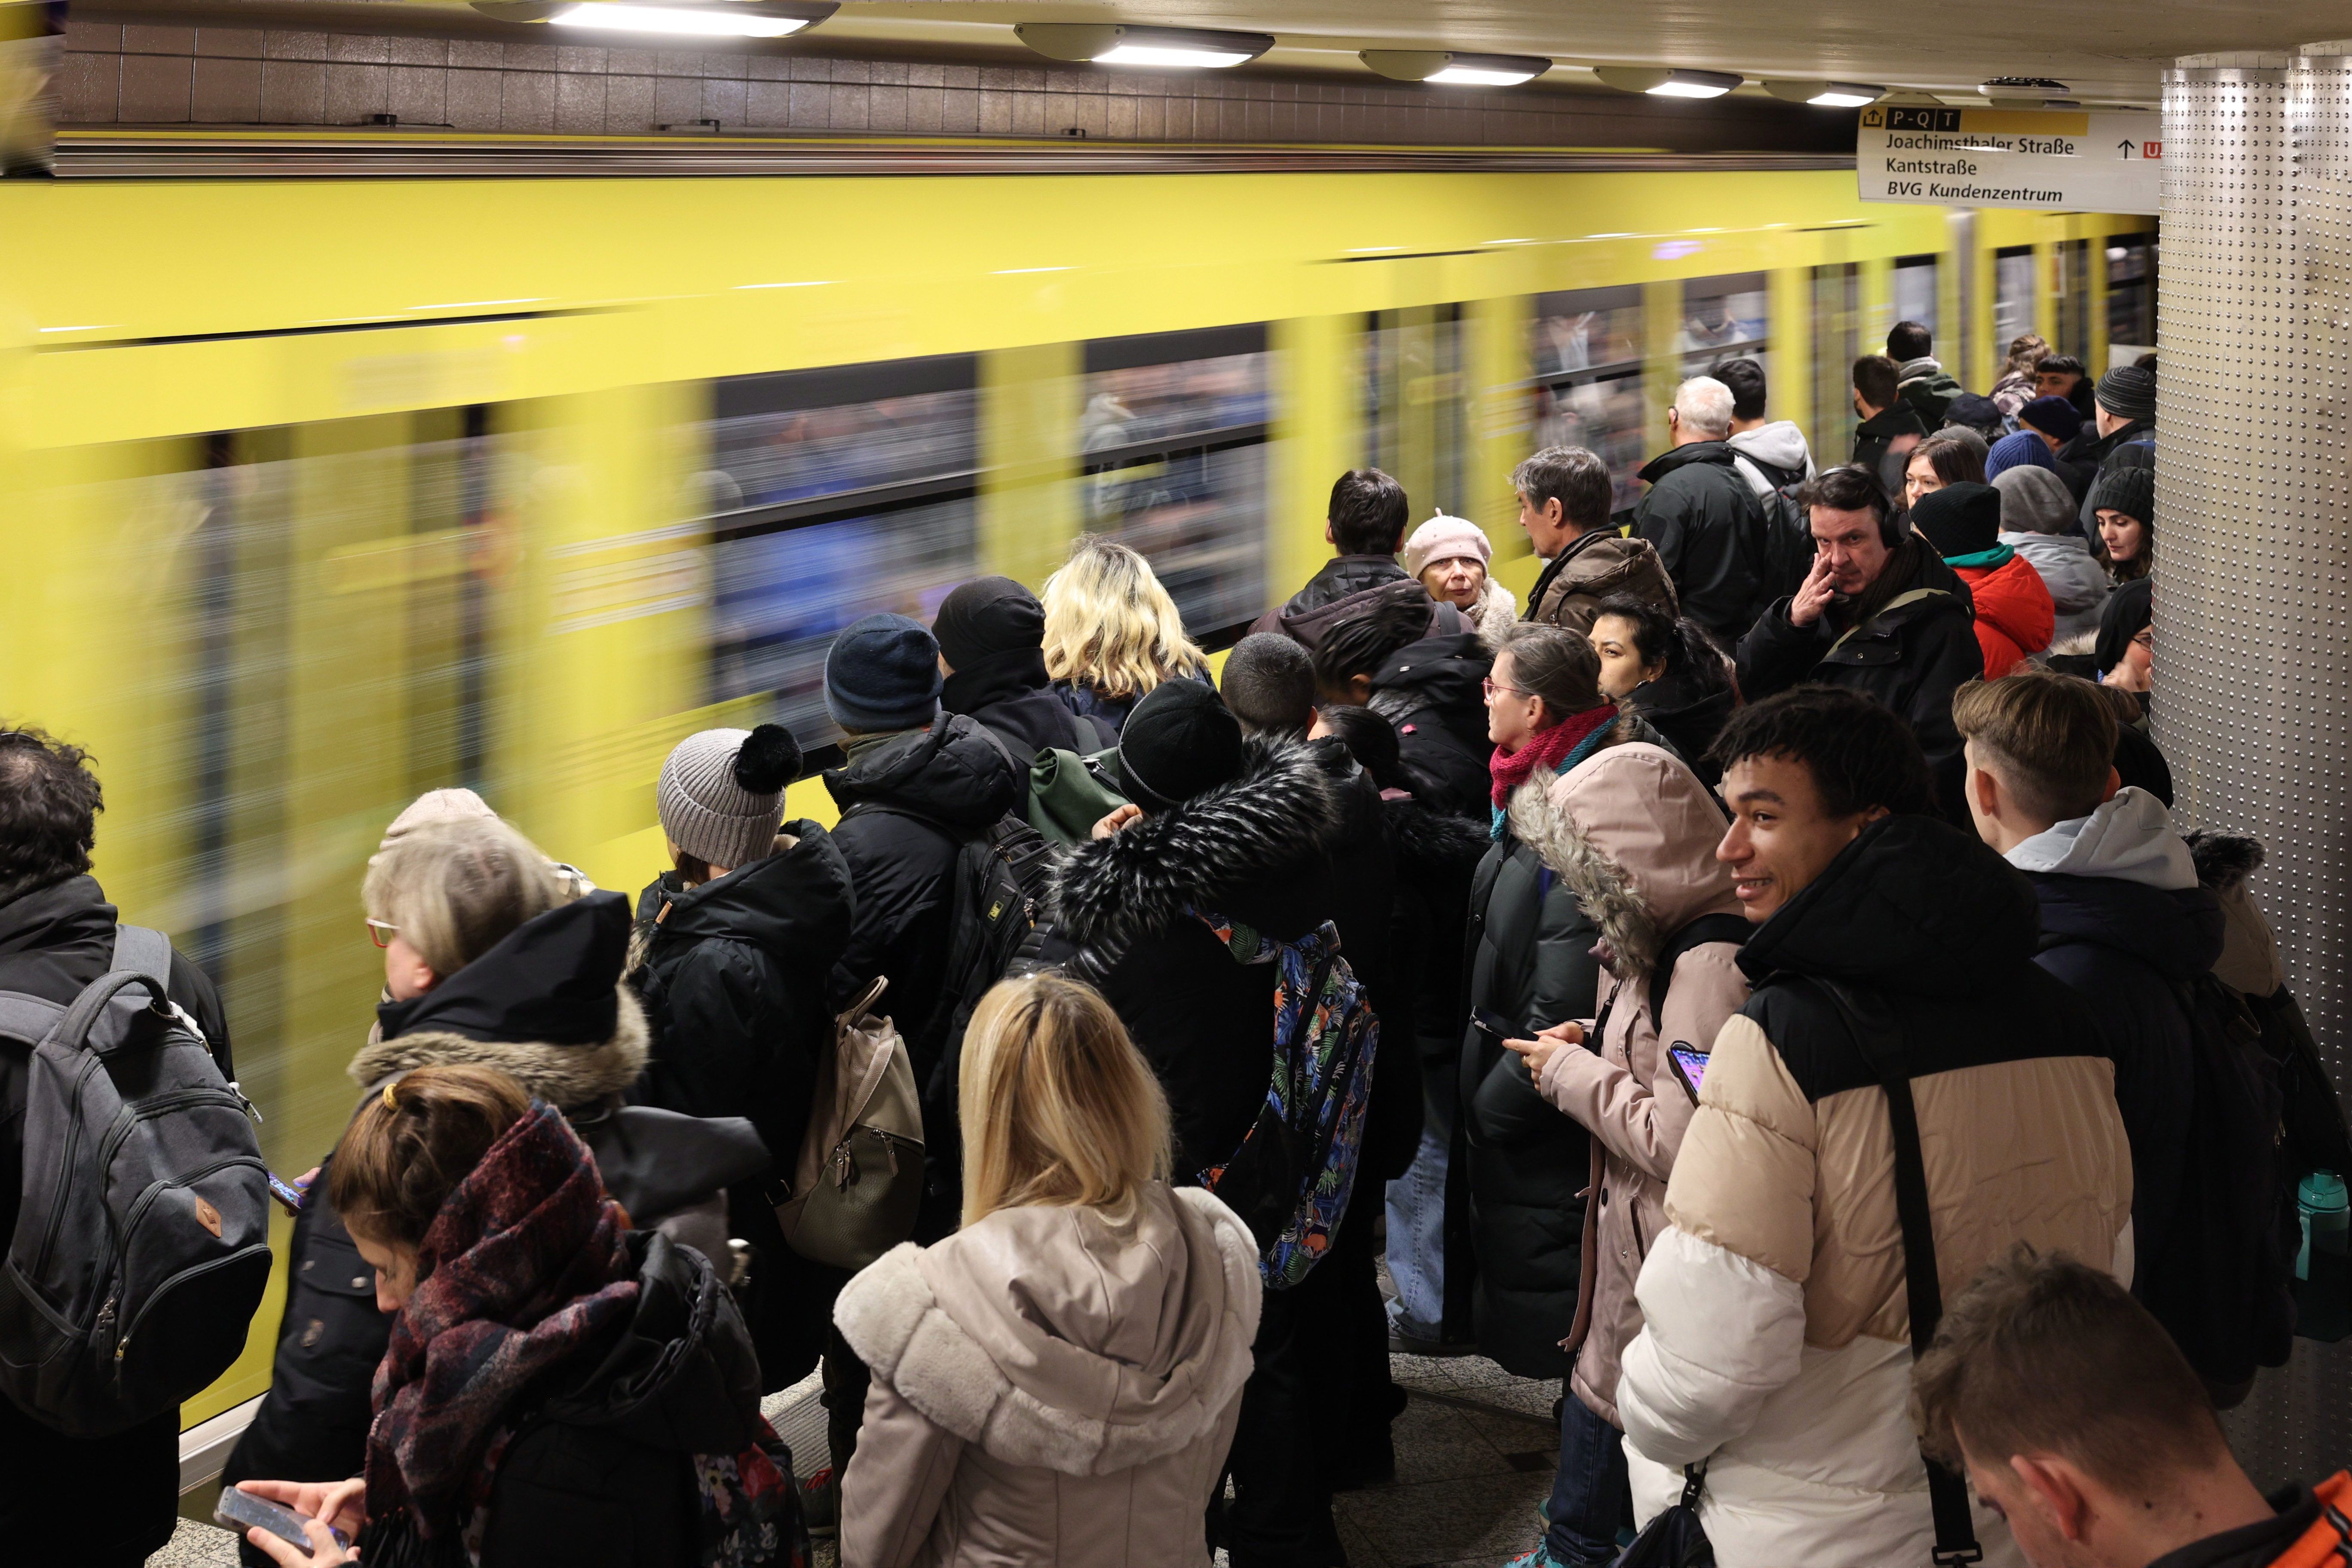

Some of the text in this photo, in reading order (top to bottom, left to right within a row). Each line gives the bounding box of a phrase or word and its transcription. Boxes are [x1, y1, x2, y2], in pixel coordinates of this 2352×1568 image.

[1944, 112, 1954, 127] T
[1886, 133, 2074, 155] Joachimsthaler Straße
[2147, 144, 2159, 157] U
[1886, 157, 1977, 175] Kantstraße
[1887, 181, 2063, 202] BVG Kundenzentrum
